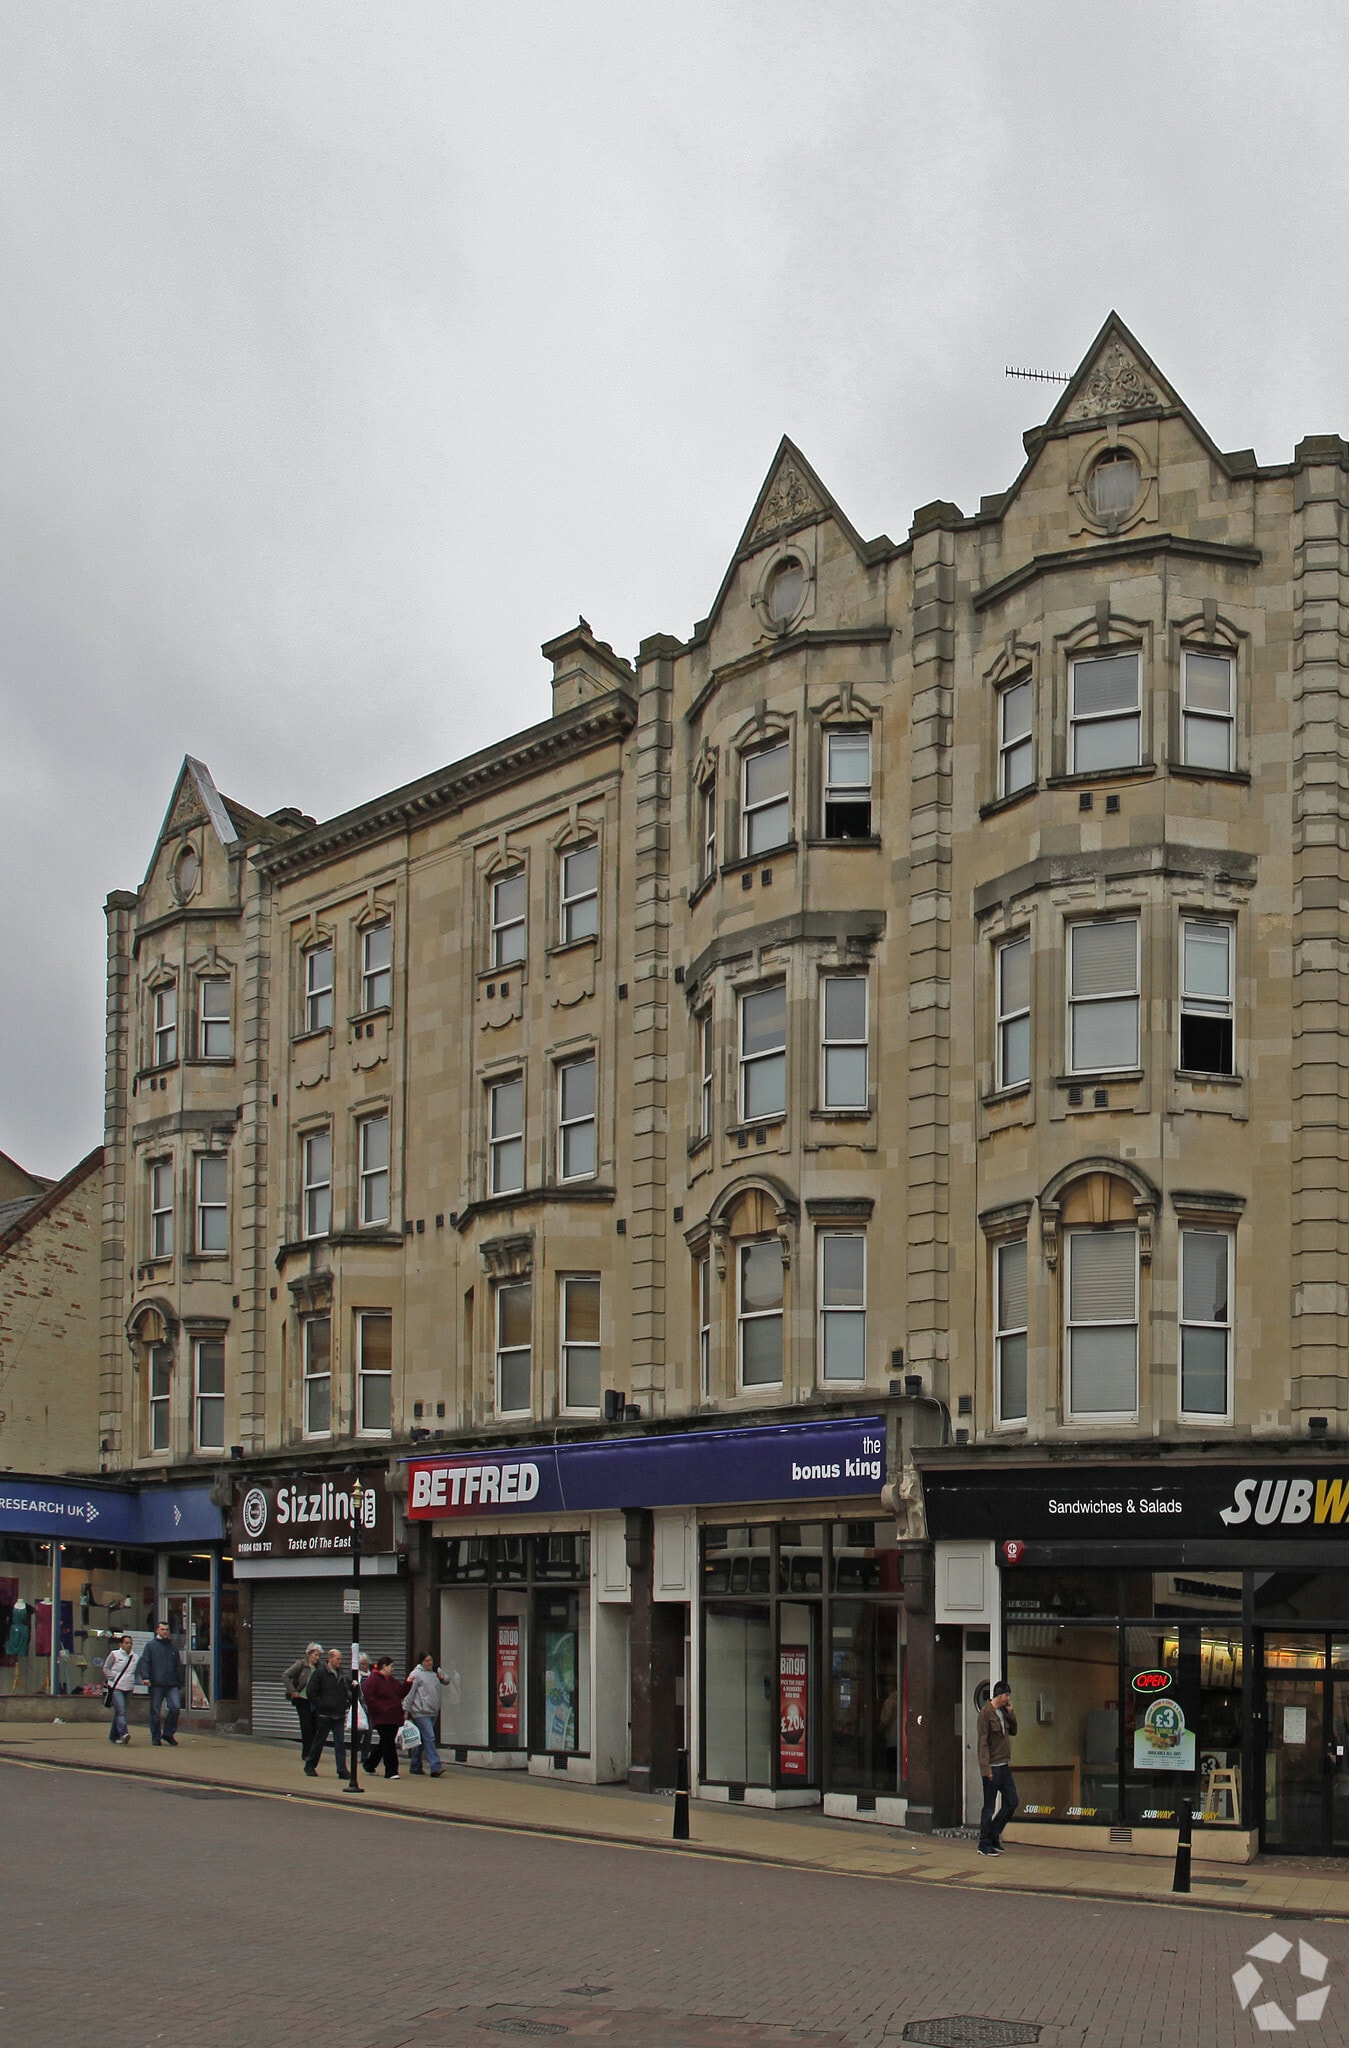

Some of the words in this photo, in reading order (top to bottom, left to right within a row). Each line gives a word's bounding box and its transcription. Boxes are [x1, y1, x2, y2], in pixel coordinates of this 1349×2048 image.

[863, 1436, 881, 1454] the
[792, 1463, 840, 1480] bonus
[845, 1458, 881, 1479] king
[412, 1463, 540, 1508] BETFRED
[0, 1498, 64, 1514] RESEARCH
[67, 1505, 85, 1516] UK
[366, 1493, 374, 1525] hut
[1048, 1500, 1123, 1514] Sandwiches
[1126, 1499, 1136, 1513] &
[1139, 1499, 1182, 1513] Salads
[1219, 1479, 1349, 1527] SUBW
[288, 1538, 307, 1550] Taste
[309, 1537, 318, 1549] Of
[319, 1537, 332, 1549] The
[334, 1536, 351, 1547] East
[499, 1630, 518, 1646] Bingo
[781, 1658, 805, 1675] Bingo
[1137, 1674, 1168, 1687] OPEN
[781, 1715, 804, 1733] £20k
[1156, 1709, 1174, 1728] £3
[1024, 1804, 1054, 1815] SUBWAY
[1067, 1806, 1097, 1817] SUBWAY
[1142, 1809, 1174, 1820] SUBWAY
[1191, 1811, 1219, 1821] UBWAY
